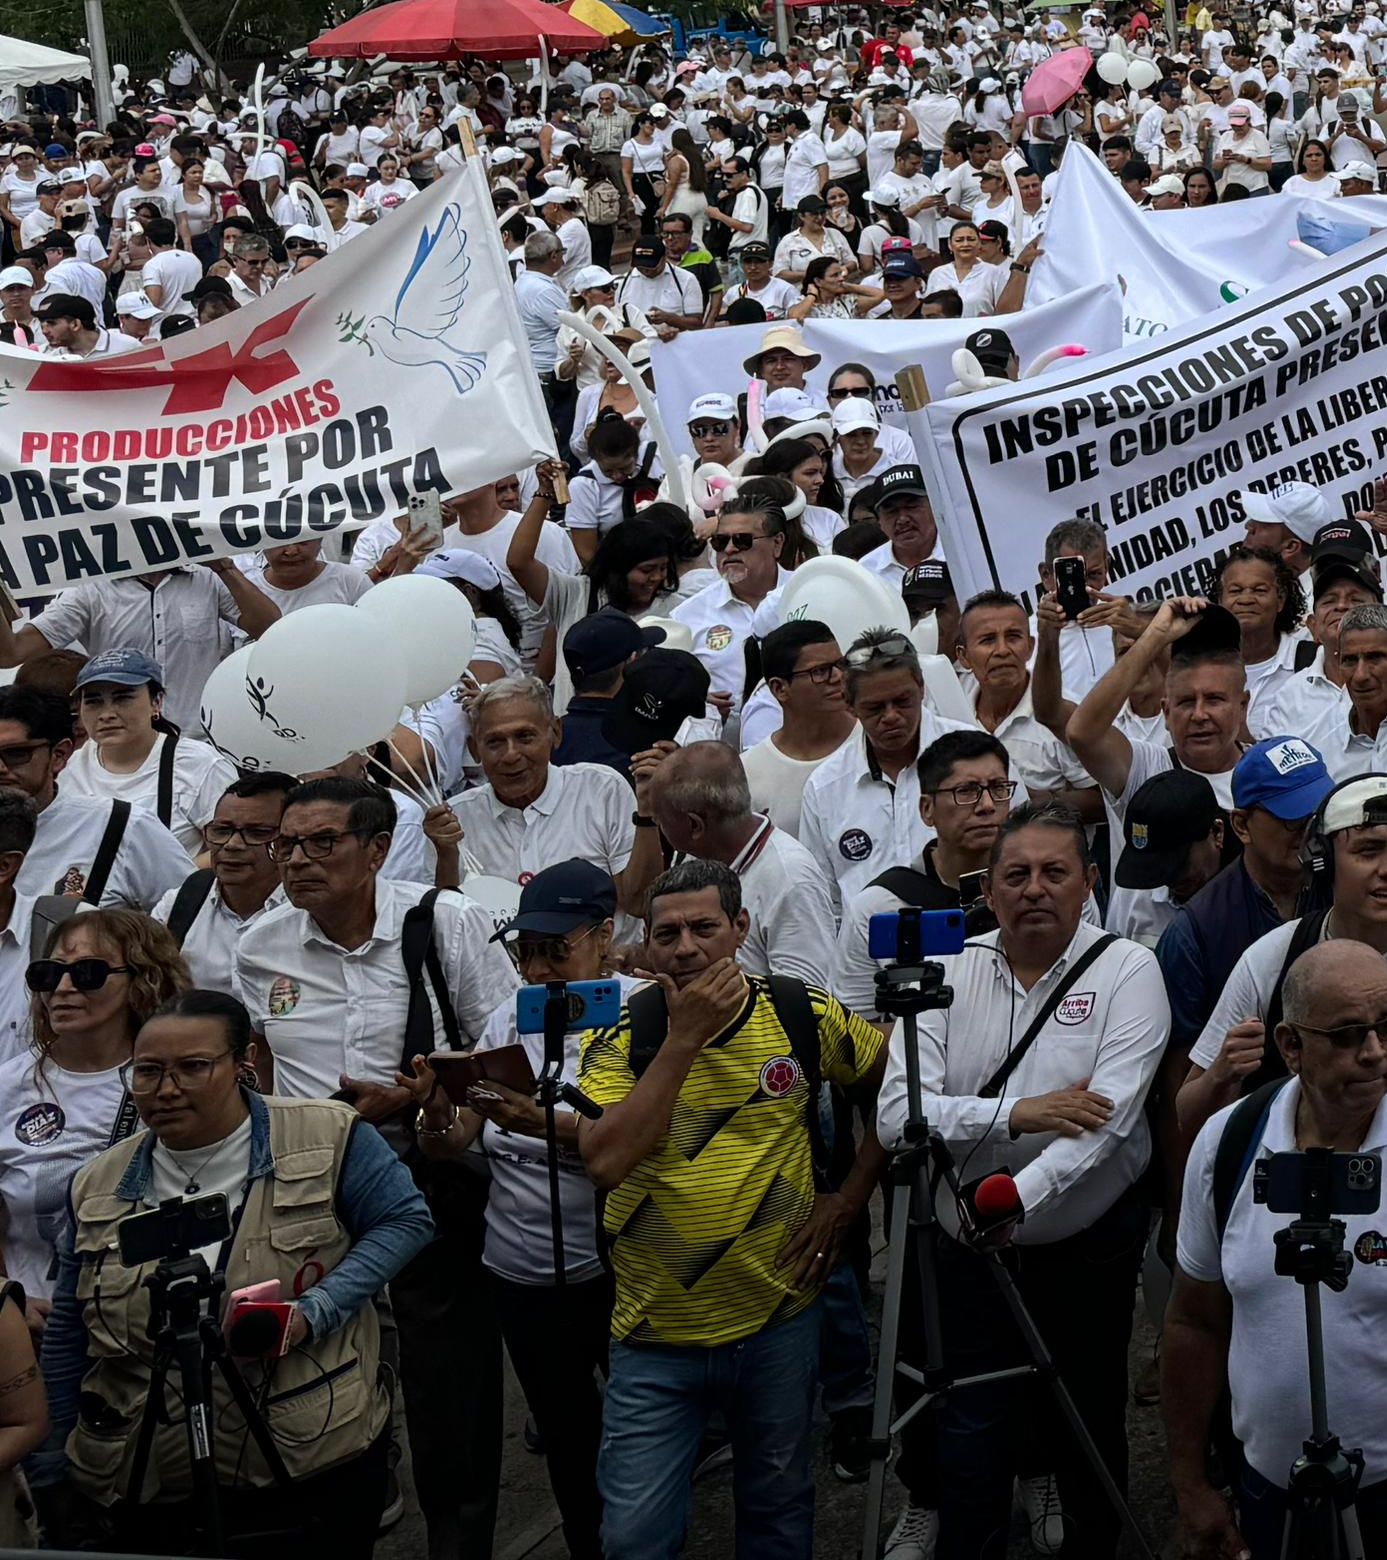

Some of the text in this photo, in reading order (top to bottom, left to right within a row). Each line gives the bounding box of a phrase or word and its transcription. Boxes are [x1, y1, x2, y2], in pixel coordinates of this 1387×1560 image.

[21, 379, 340, 464] PRODUCCIONES
[984, 323, 1288, 465] INSPECCIONES
[1284, 297, 1342, 341] DE
[1046, 443, 1100, 492] DE
[1109, 376, 1267, 468] CÚCUTA
[285, 405, 395, 484] POR
[882, 470, 914, 486] DUBAI
[1111, 438, 1242, 532] EJERCICIO
[1250, 424, 1283, 464] DE
[1283, 407, 1319, 447] LA
[23, 521, 131, 587] PAZ
[131, 511, 214, 570] DE
[219, 447, 453, 548] CÚCUTA
[1106, 518, 1198, 587] NIDAD,
[1196, 488, 1245, 539] LOS
